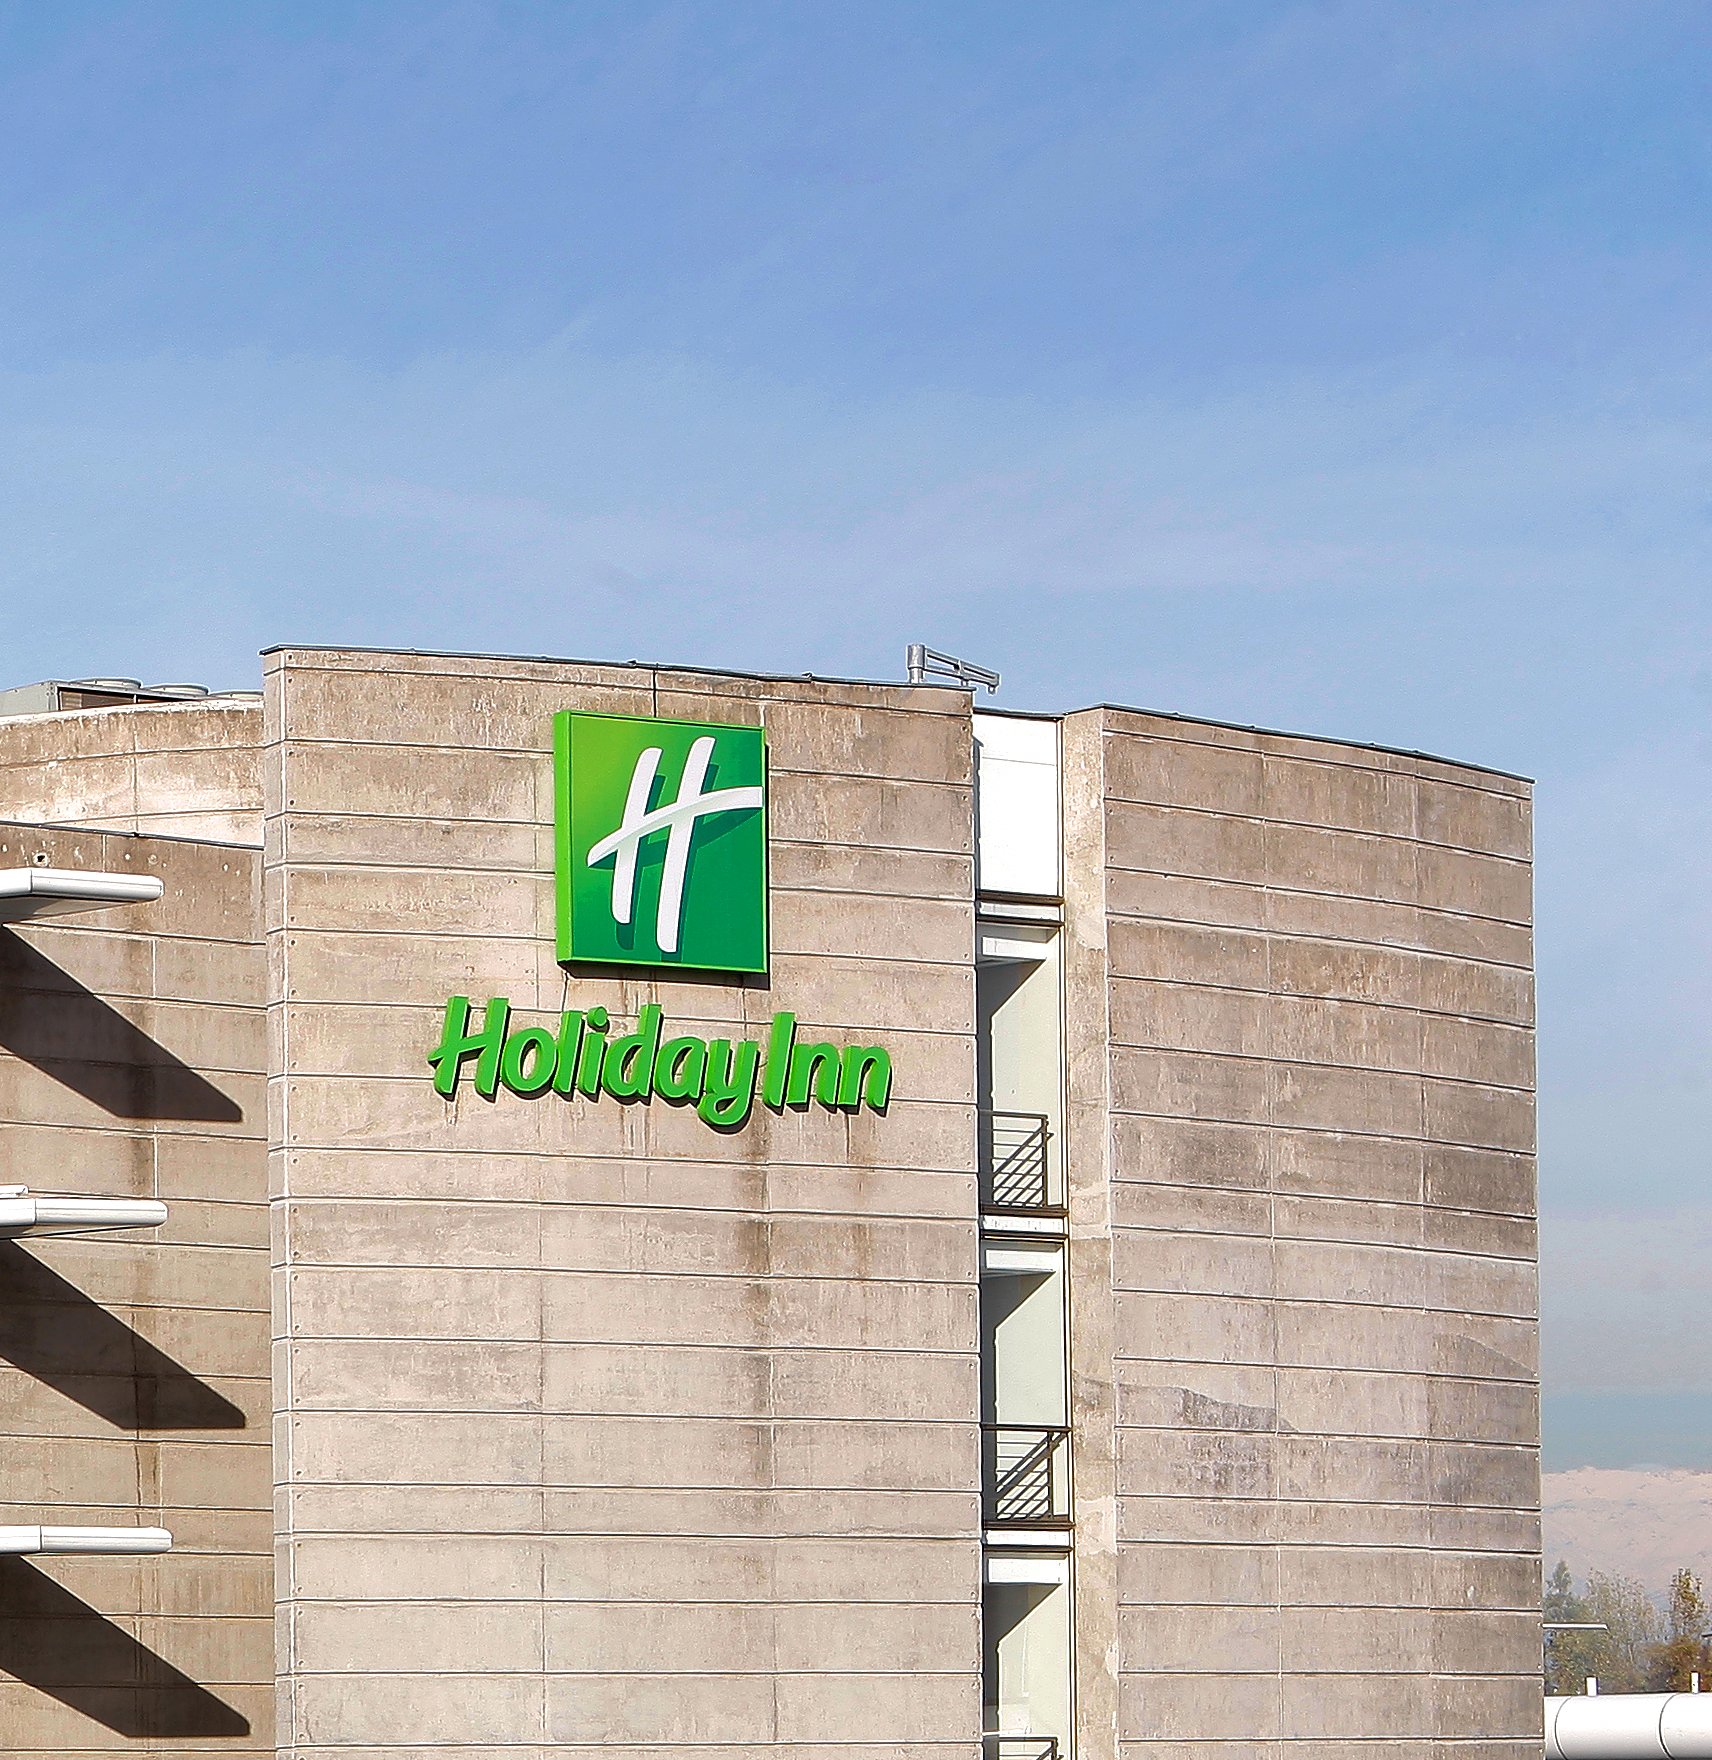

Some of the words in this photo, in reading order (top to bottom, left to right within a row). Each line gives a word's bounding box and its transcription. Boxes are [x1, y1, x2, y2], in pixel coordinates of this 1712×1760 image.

[587, 736, 763, 953] H
[428, 995, 759, 1126] Holiday
[764, 1012, 892, 1109] Inn
